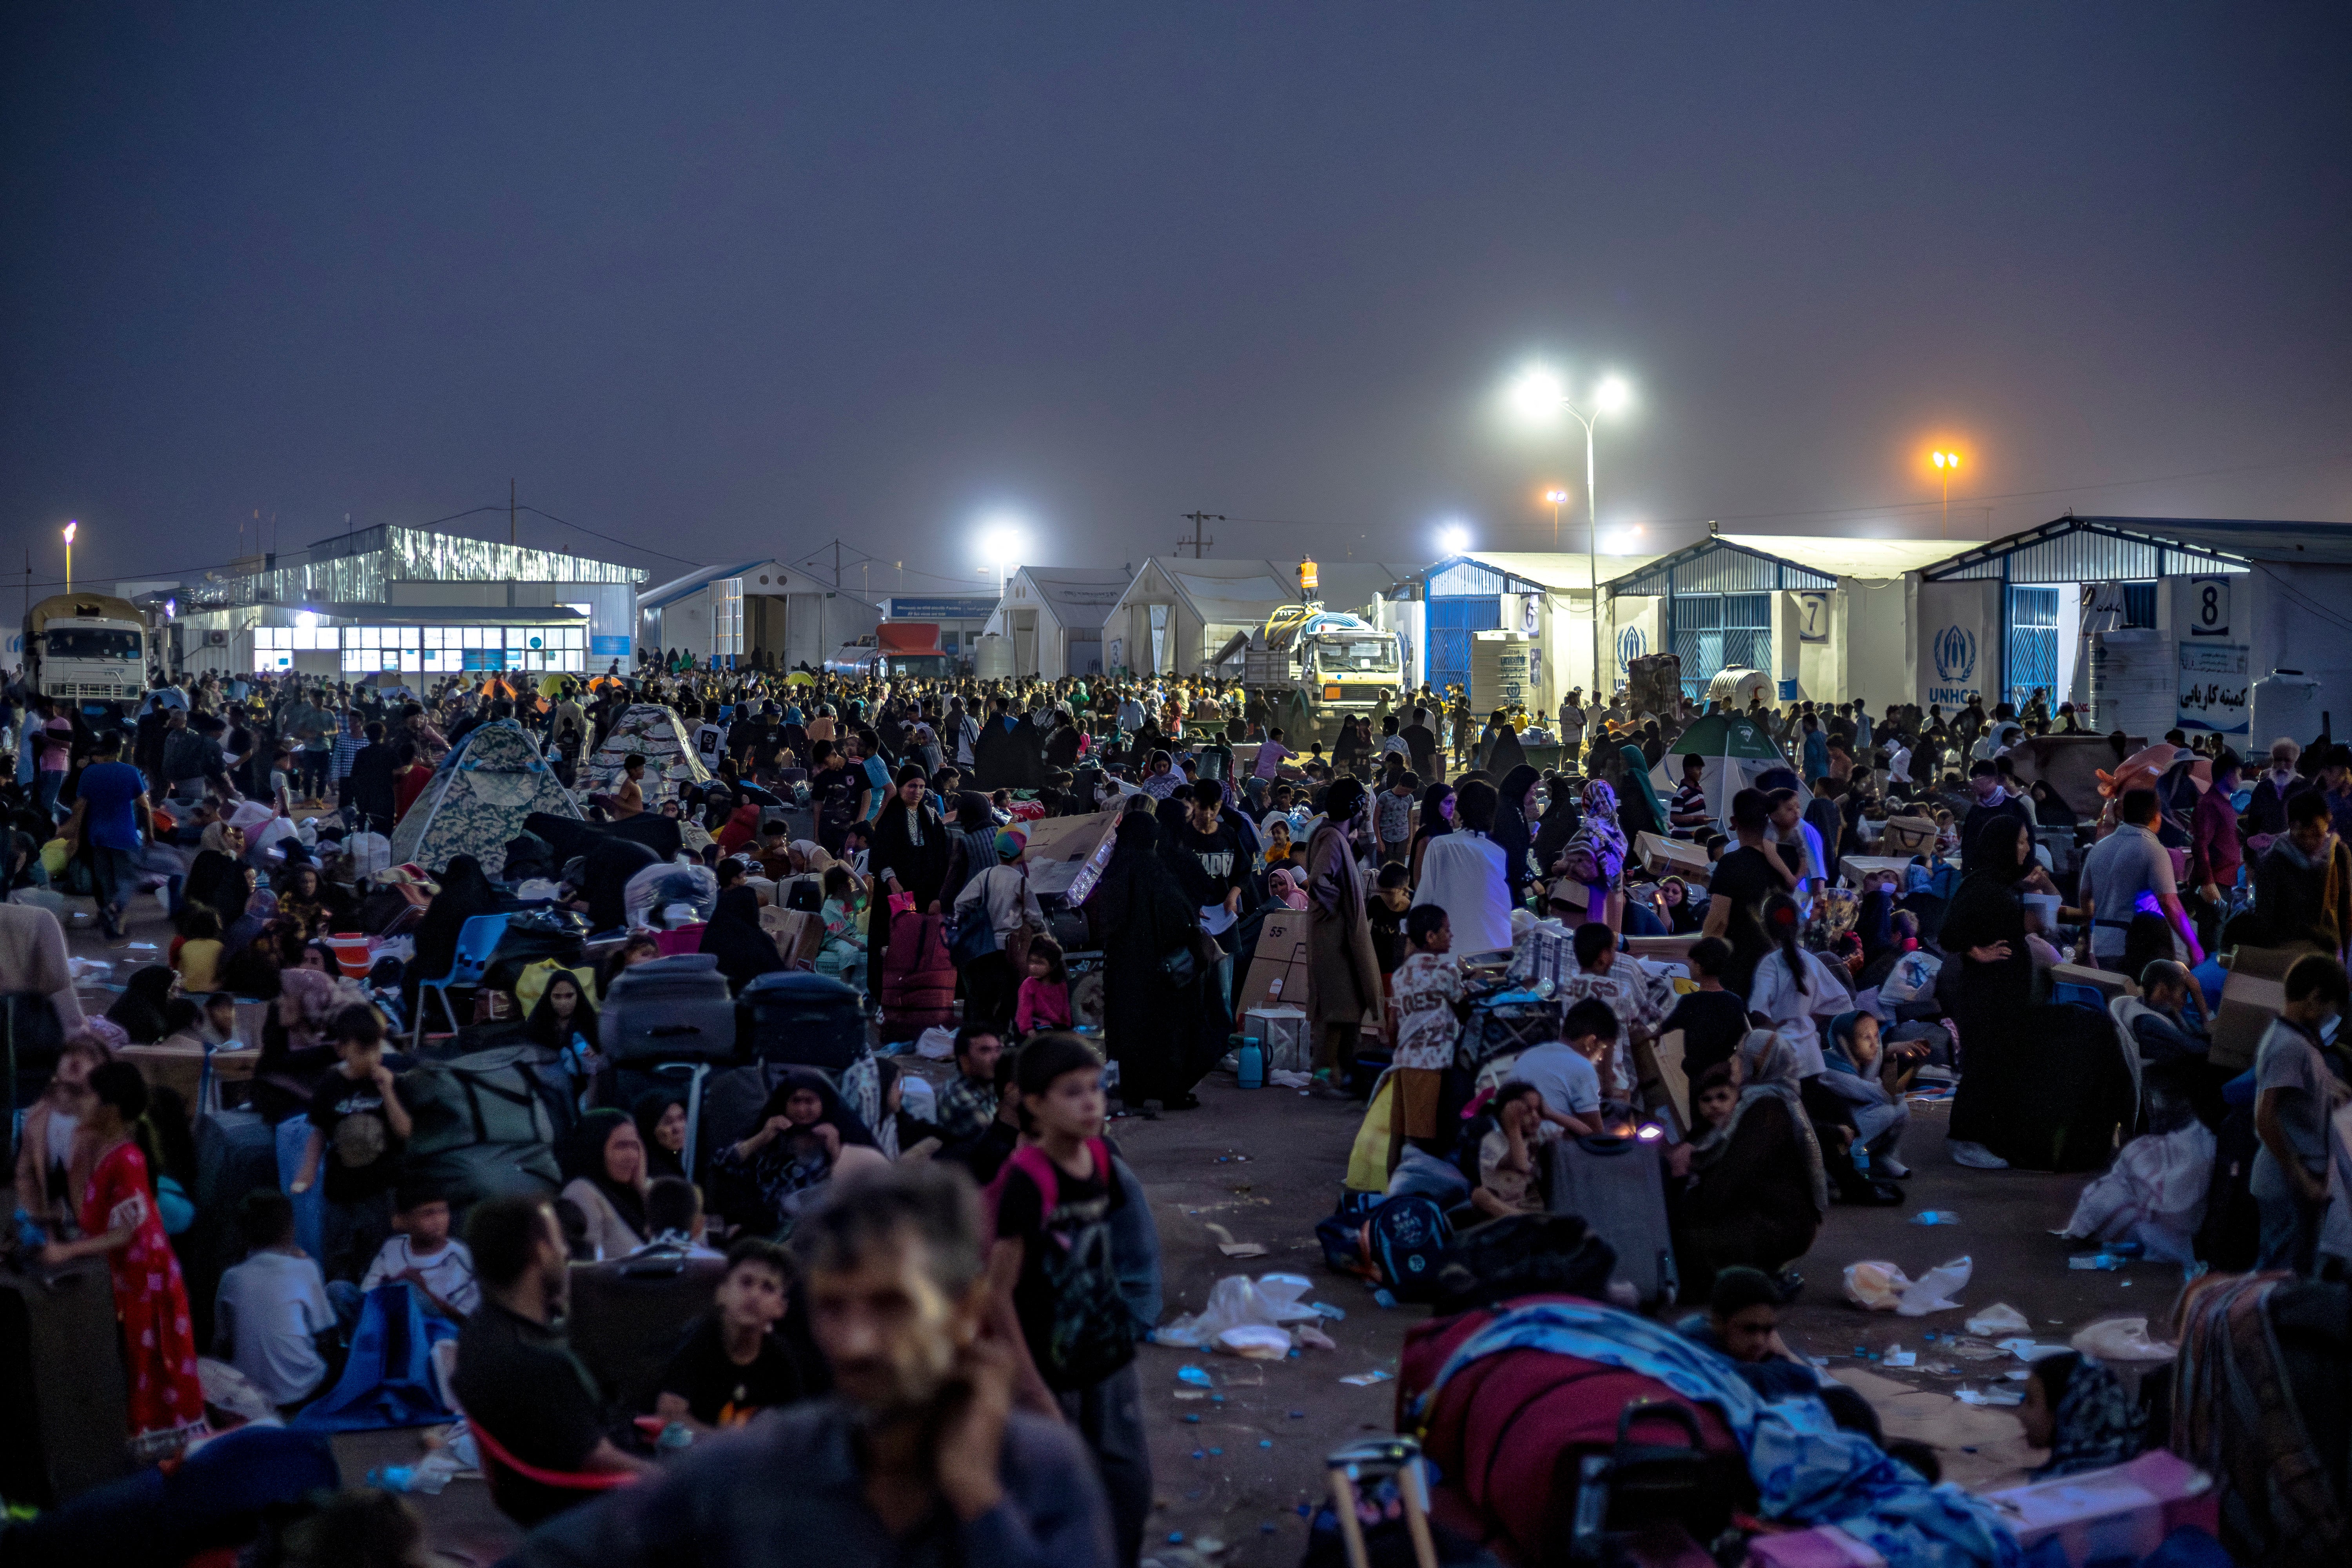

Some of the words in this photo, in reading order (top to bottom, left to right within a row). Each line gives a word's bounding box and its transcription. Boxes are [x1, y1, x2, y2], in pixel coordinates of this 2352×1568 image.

[1526, 602, 1534, 628] 6
[1808, 602, 1818, 631] 7
[2201, 586, 2218, 625] 8
[1113, 644, 1119, 665] 3
